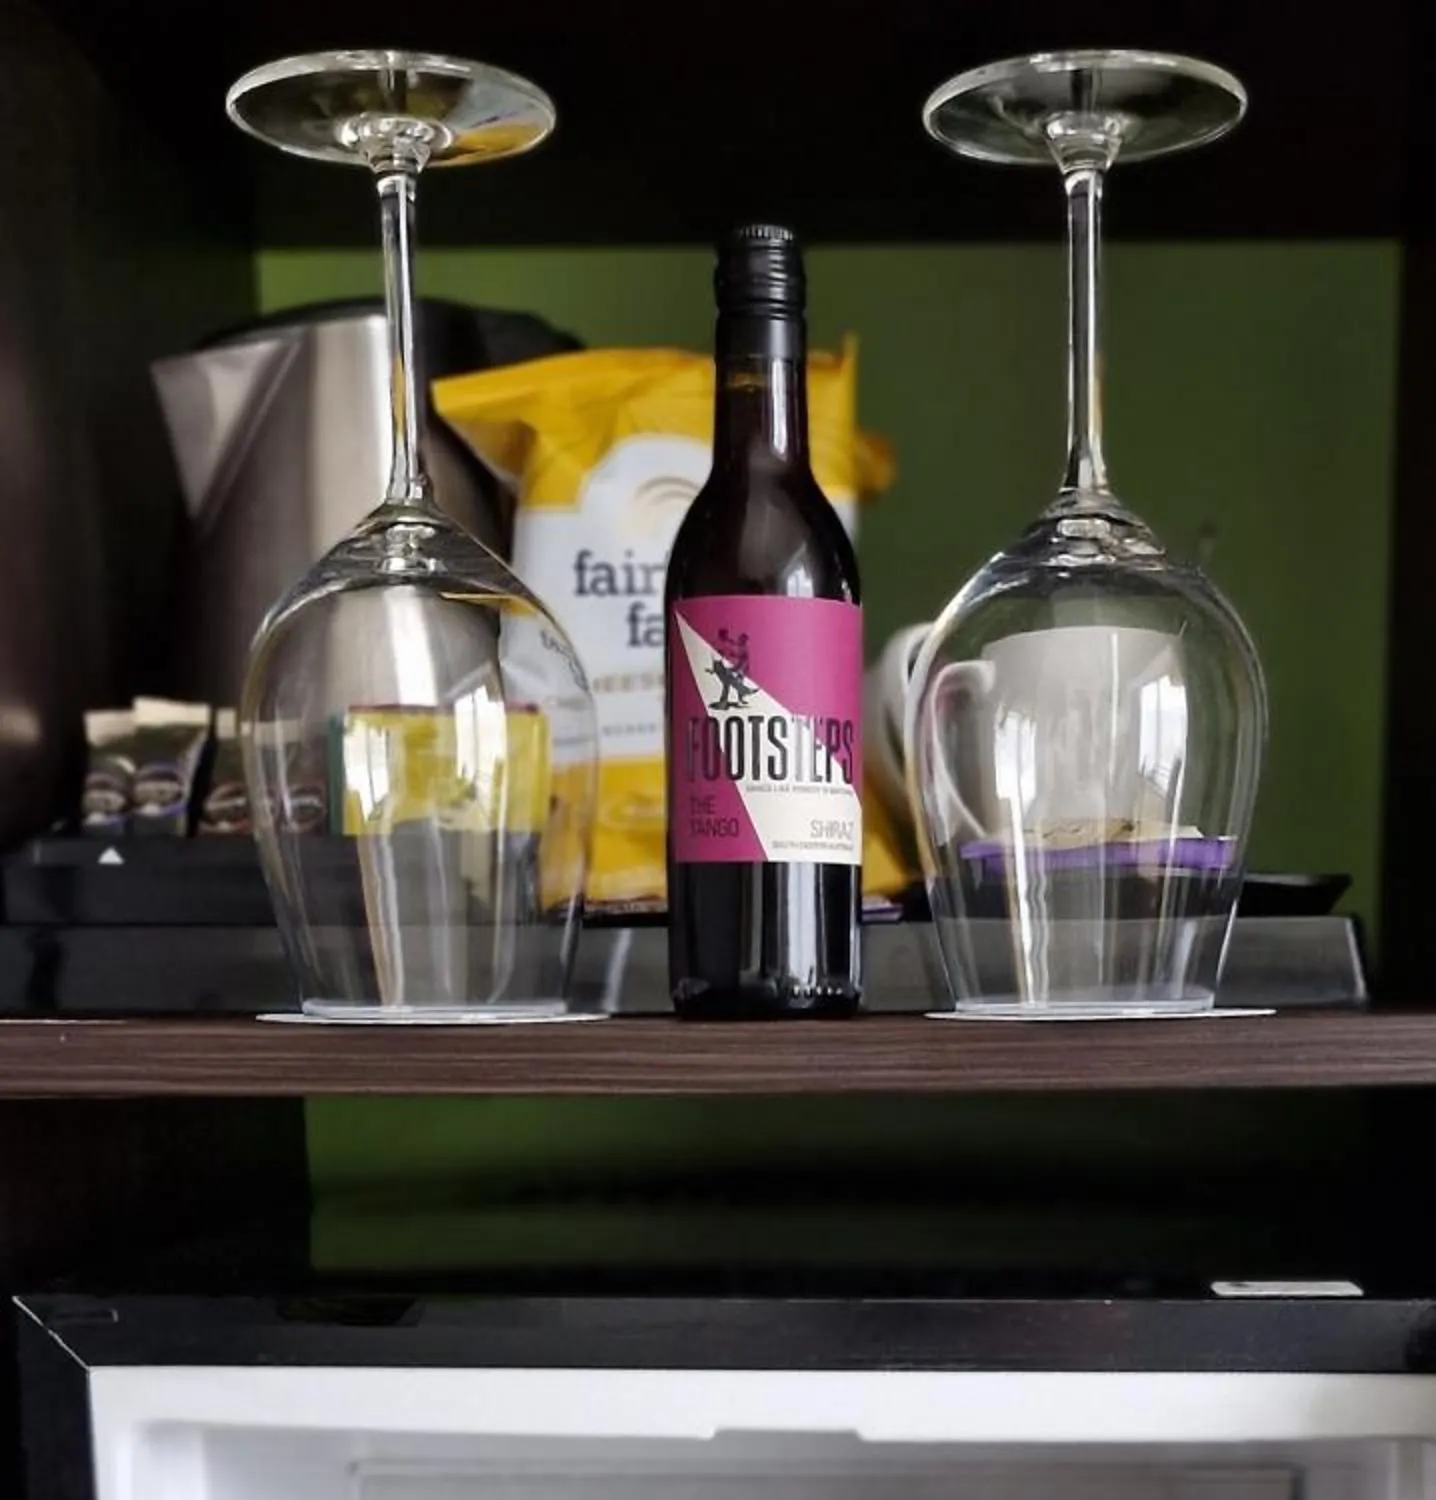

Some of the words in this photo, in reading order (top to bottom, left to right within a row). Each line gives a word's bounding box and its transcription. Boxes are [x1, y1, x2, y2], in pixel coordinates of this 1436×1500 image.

[573, 549, 667, 597] fair
[625, 601, 665, 648] fa
[686, 714, 855, 785] FOOTSTEPS
[810, 819, 854, 841] SHIRAZ
